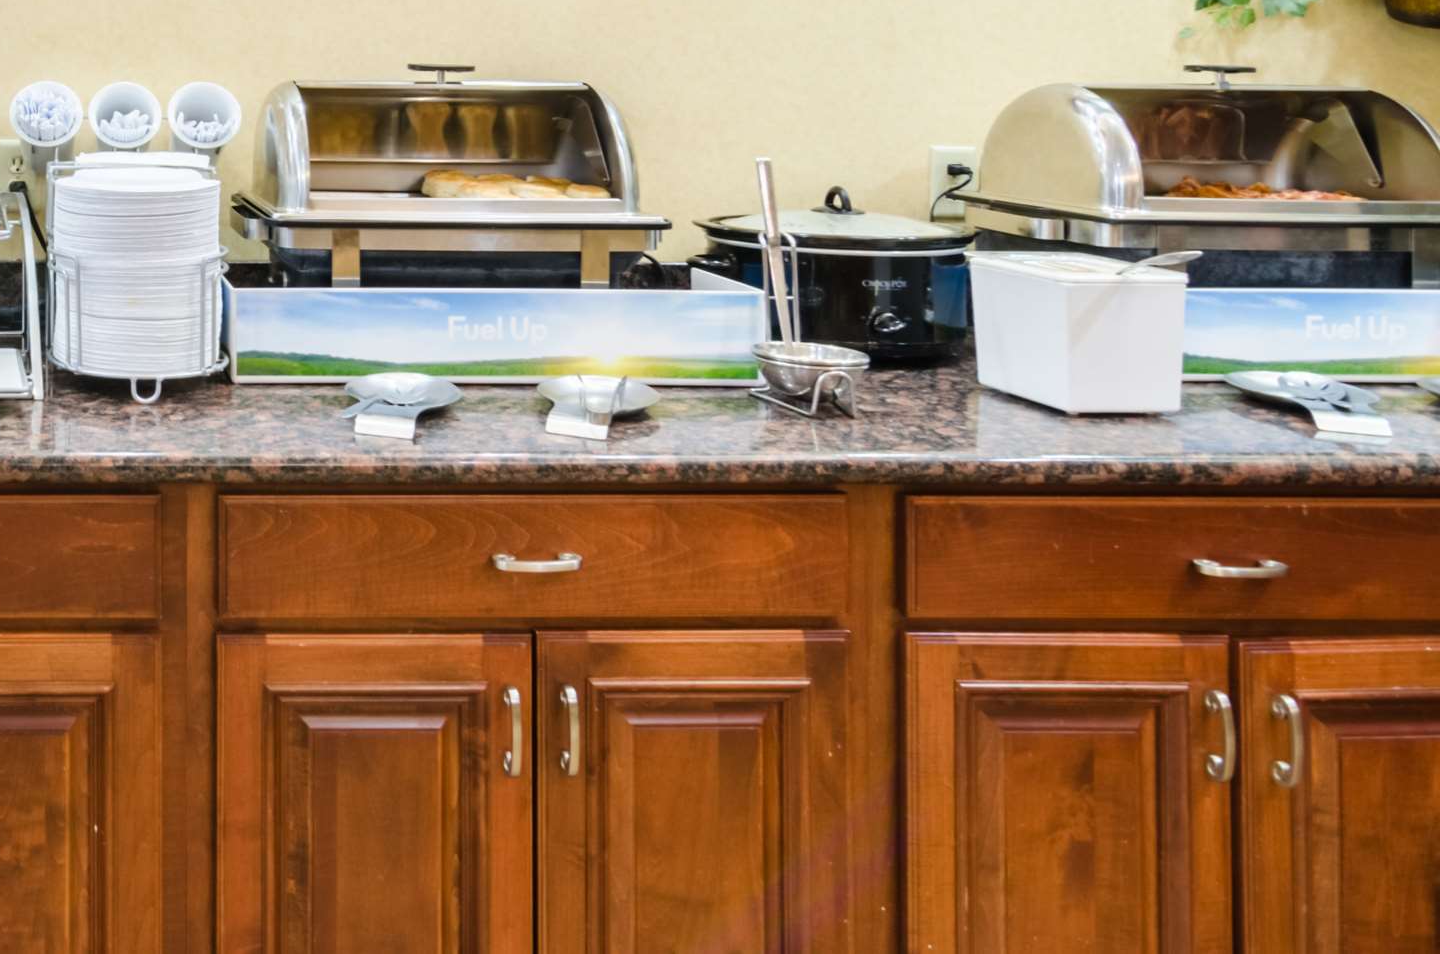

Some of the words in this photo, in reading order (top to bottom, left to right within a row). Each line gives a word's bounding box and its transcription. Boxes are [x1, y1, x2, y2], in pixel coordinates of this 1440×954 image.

[447, 315, 504, 342] Fuel
[511, 315, 548, 347] Up
[1305, 314, 1362, 341] Fuel
[1367, 314, 1407, 347] Up
